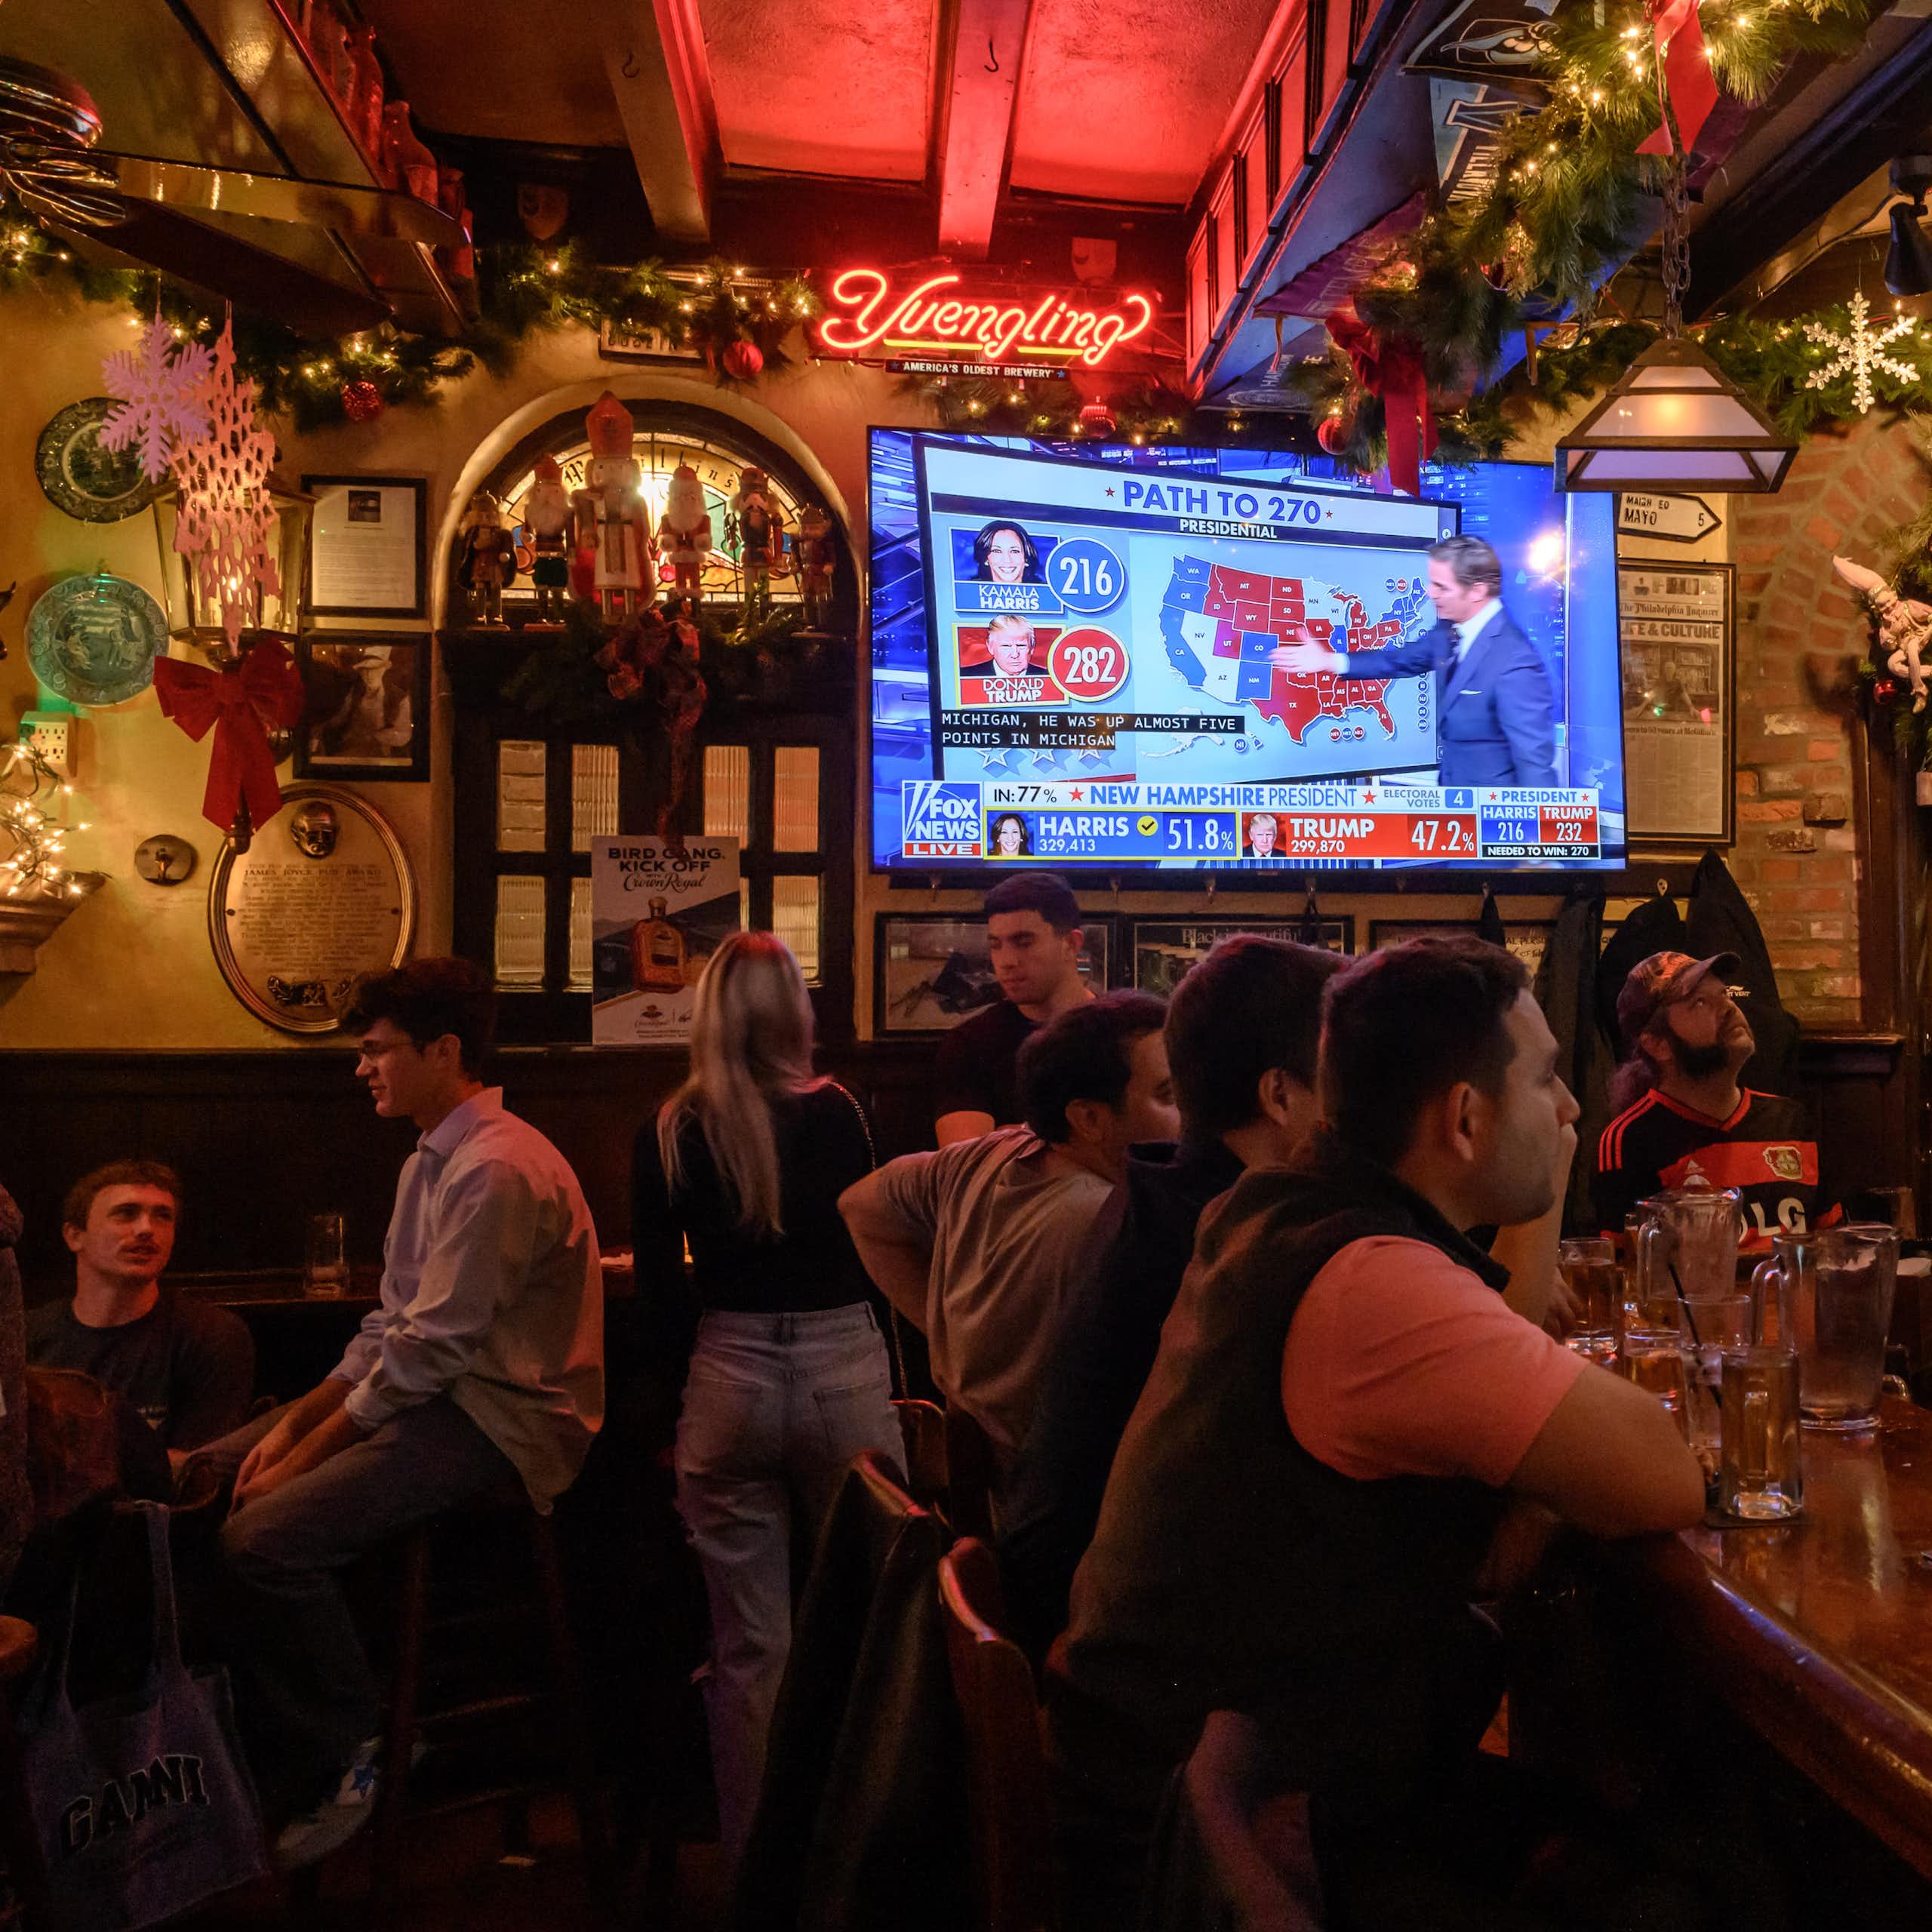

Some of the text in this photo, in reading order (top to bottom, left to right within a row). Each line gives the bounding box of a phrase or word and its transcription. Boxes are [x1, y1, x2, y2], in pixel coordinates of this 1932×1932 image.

[821, 269, 1152, 365] Yuengling
[903, 362, 1051, 378] AMERICA'S OLDEST BREWERY
[1124, 481, 1321, 524] PATH TO 270
[1625, 508, 1704, 526] MAYO 5
[1180, 519, 1278, 539] PRESIDENTIAL
[1060, 558, 1111, 595] 216
[979, 585, 1039, 598] KAMALA
[981, 597, 1040, 611] HARRIS
[1647, 623, 1659, 635] &
[1661, 623, 1720, 639] CULTURE
[1063, 646, 1117, 684] 282
[983, 678, 1044, 692] DONALD
[986, 689, 1041, 703] TRUMP
[1040, 715, 1057, 727] HE
[1068, 716, 1096, 728] WAS
[1106, 716, 1124, 728] UP
[1135, 718, 1190, 729] ALMOST
[1199, 718, 1235, 730] FIVE
[942, 732, 1115, 746] POINTS IN MICHIGAN
[1091, 786, 1357, 807] NEW HAMPSHIRE PRESIDENT
[1383, 789, 1464, 806] ELECTORAL 4
[1407, 798, 1441, 808] VOTES
[1502, 791, 1577, 803] PRESIDENT
[929, 798, 978, 820] FOX
[1483, 806, 1593, 820] HARRIS TRUMP
[915, 820, 979, 840] NEWS
[1039, 816, 1233, 851] HARRIS 51.8%
[1290, 818, 1474, 851] TRUMP 47.2%
[1498, 822, 1582, 841] 216 232
[608, 848, 656, 859] BIRD
[913, 844, 974, 855] LIVE
[1039, 839, 1096, 854] 329,413
[1291, 840, 1346, 855] 299,870
[1488, 847, 1589, 856] NEEDED TO WIN: 270
[620, 860, 710, 872] KICK OFF
[623, 873, 707, 893] Crown Royal
